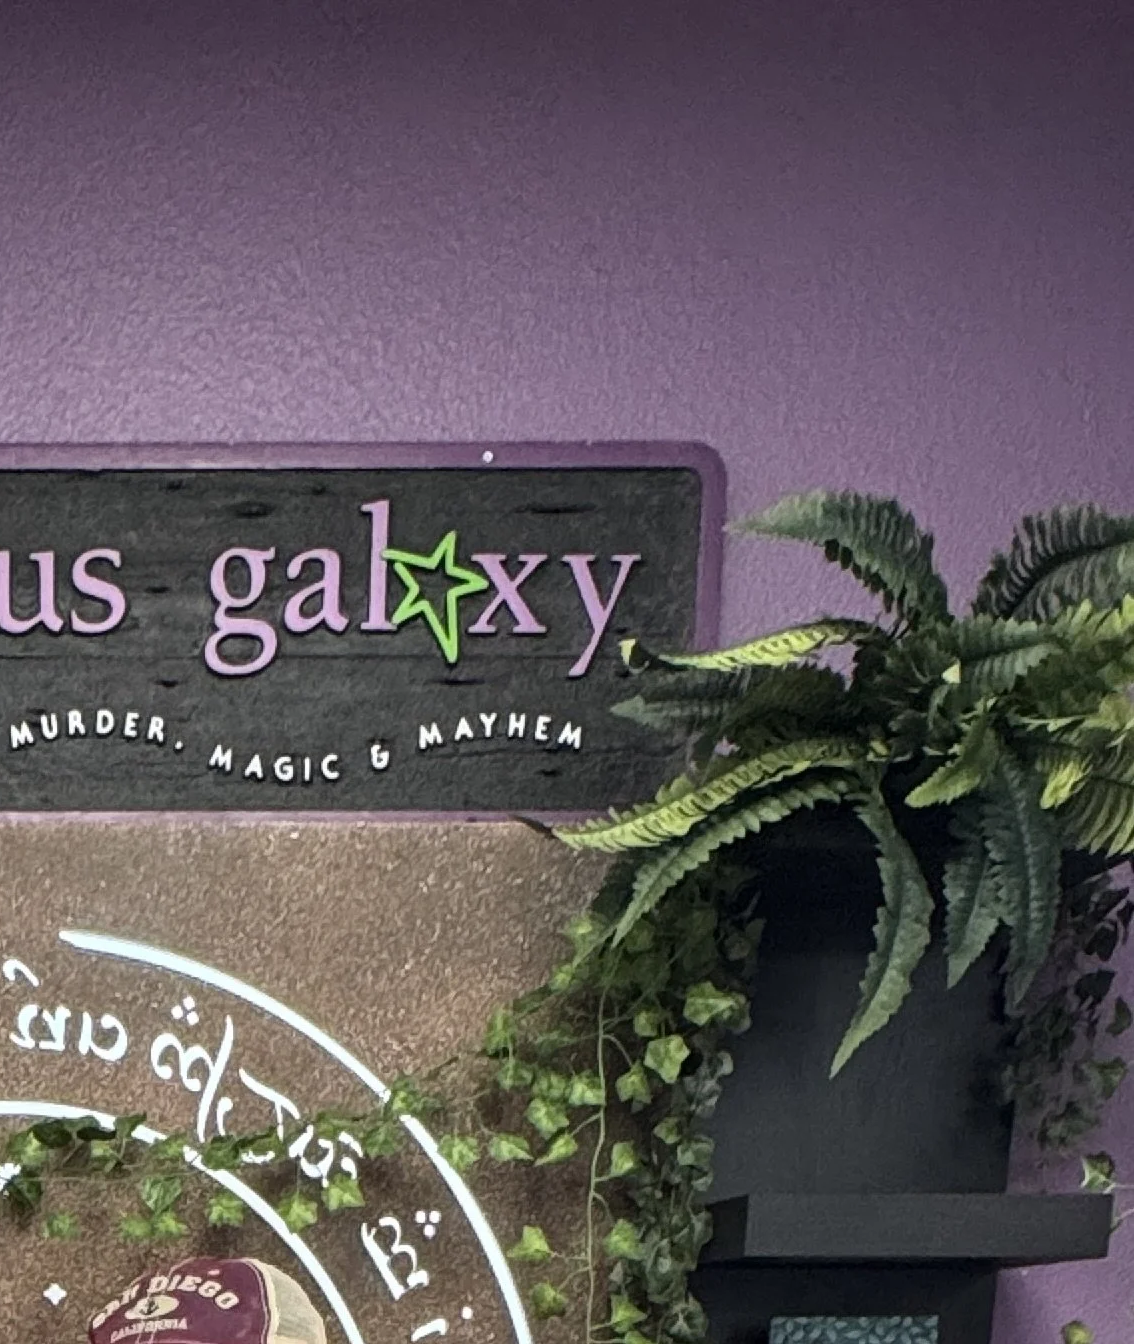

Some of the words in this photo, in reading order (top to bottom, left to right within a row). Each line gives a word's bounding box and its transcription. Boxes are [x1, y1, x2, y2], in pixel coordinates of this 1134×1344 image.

[203, 500, 642, 678] galaxy
[209, 743, 340, 783] MAGIC
[370, 744, 390, 771] &
[418, 711, 584, 751] MAYHEM
[146, 1274, 240, 1310] DIEGO
[109, 1317, 189, 1344] CALIFORNIA
